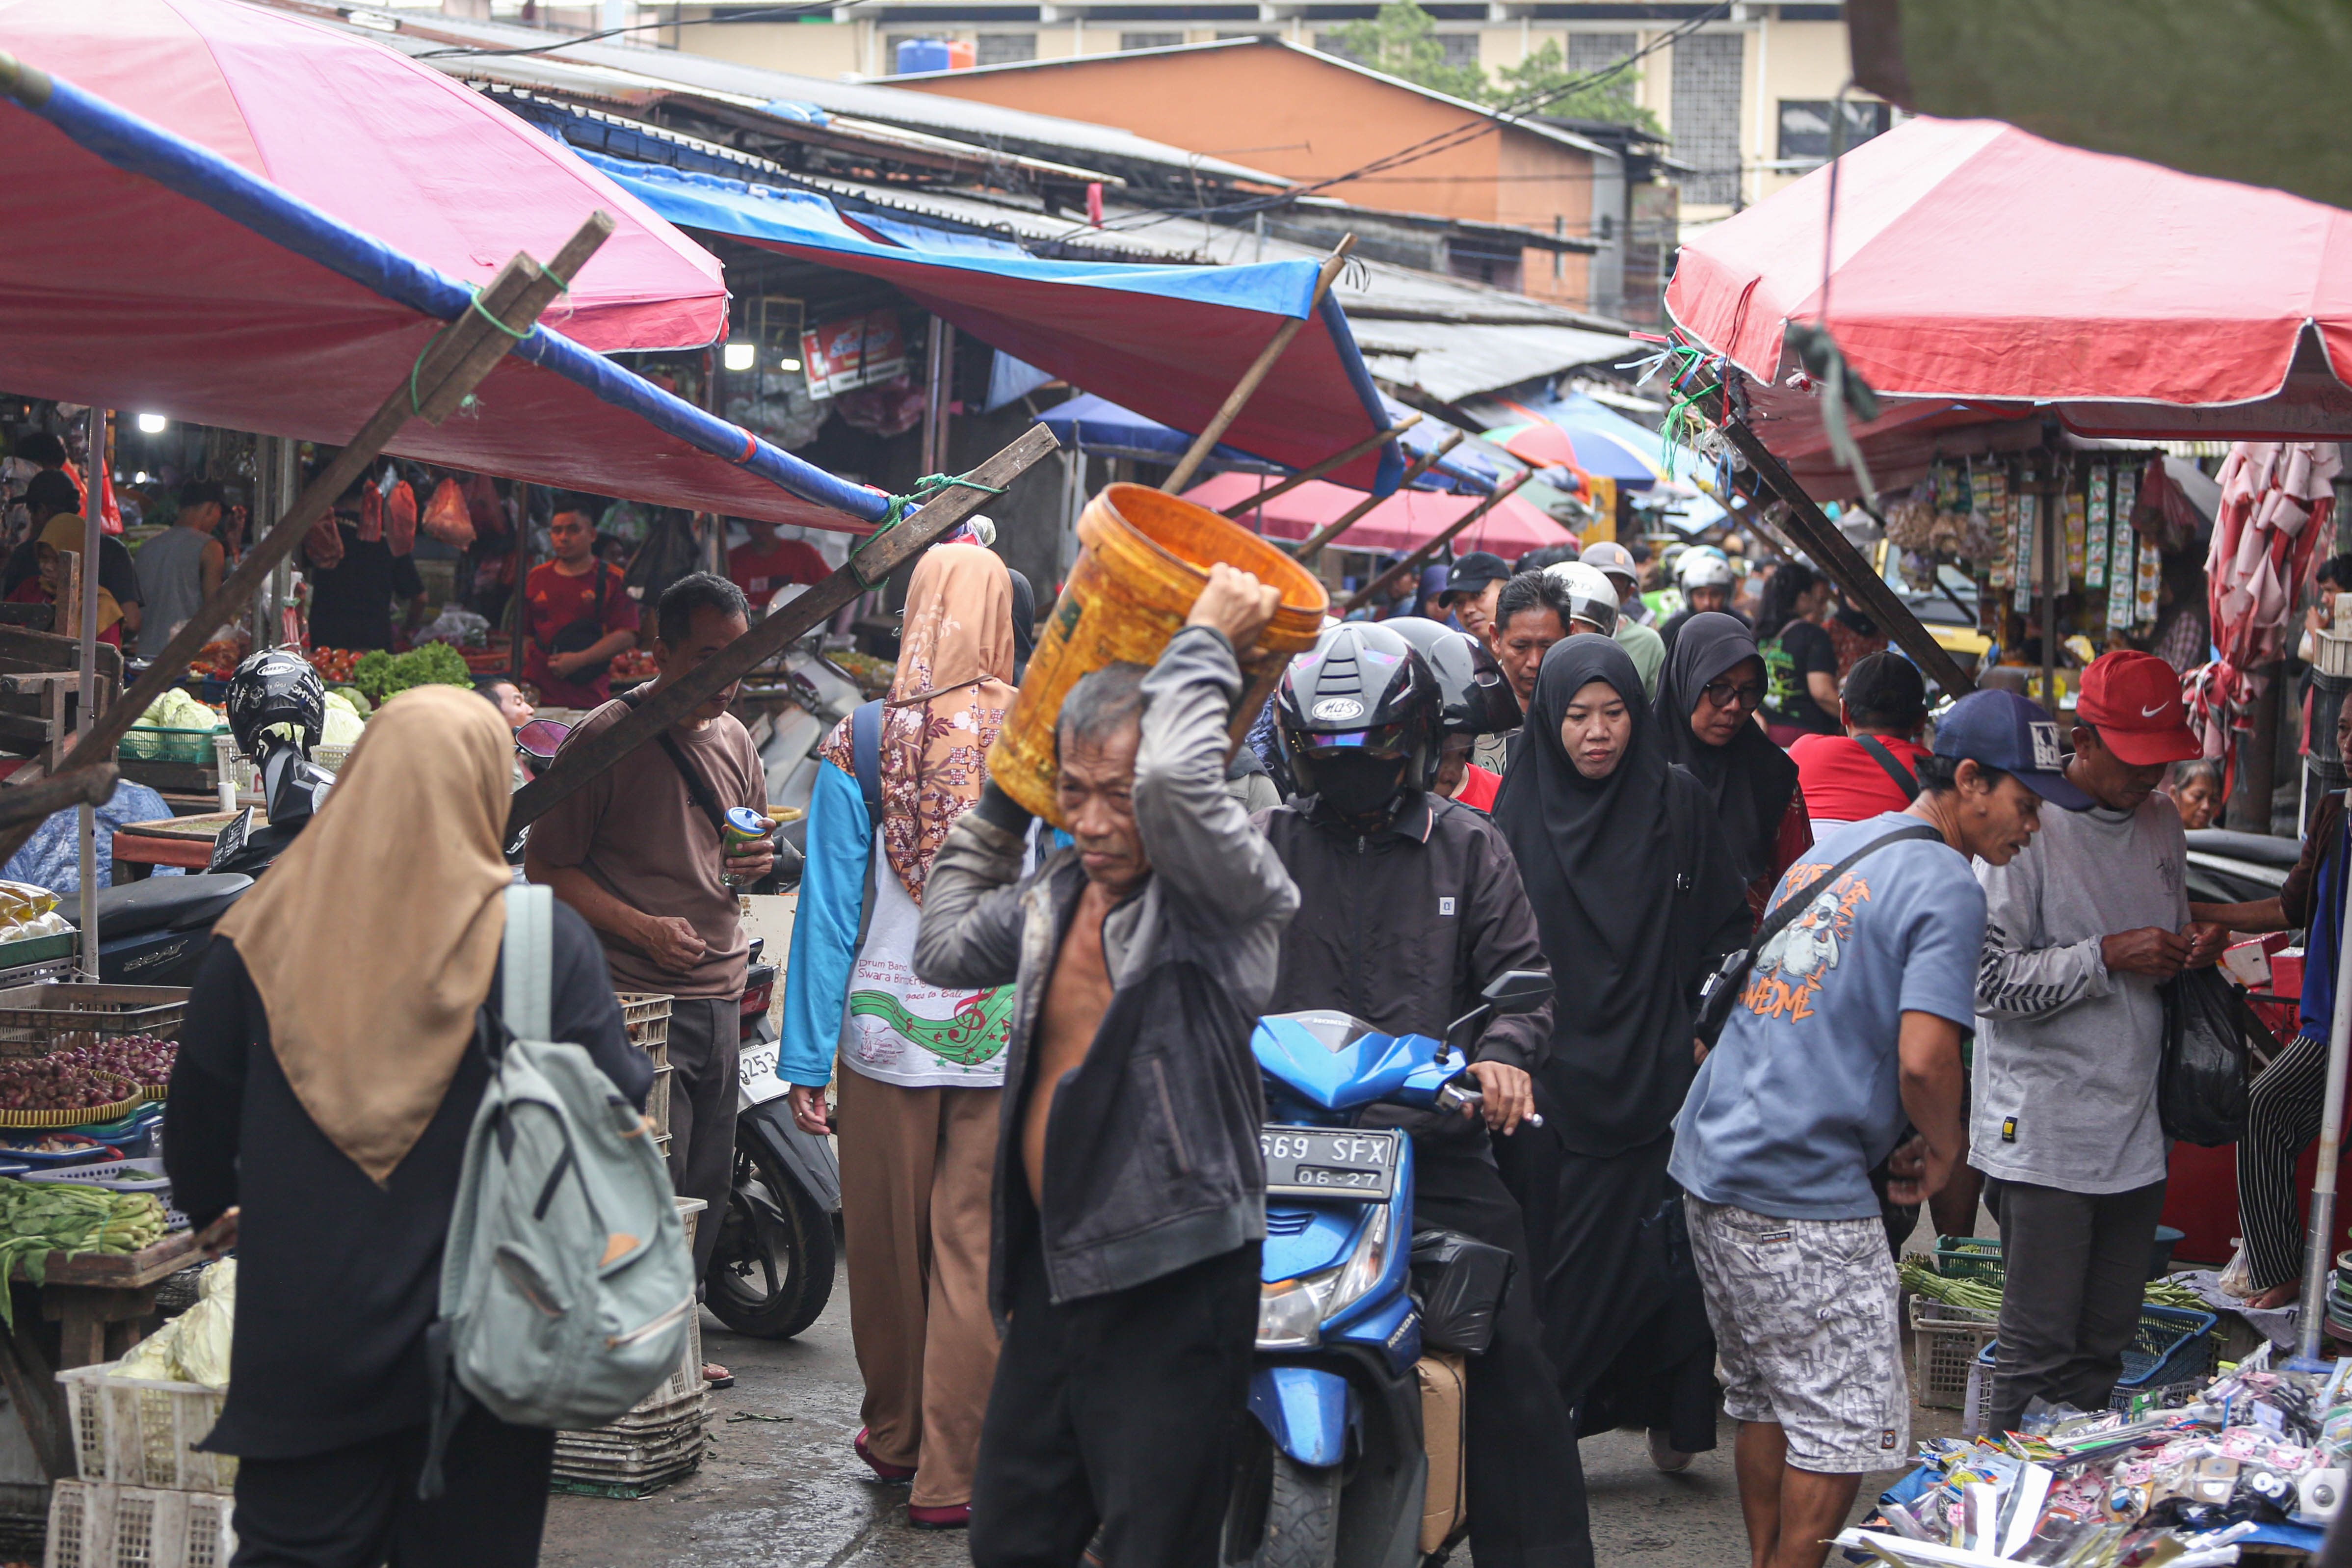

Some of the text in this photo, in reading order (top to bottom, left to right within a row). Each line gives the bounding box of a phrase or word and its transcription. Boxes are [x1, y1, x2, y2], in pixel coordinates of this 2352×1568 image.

[859, 959, 885, 968] Drum
[858, 968, 891, 982] Swara
[905, 993, 925, 1002] goes
[941, 988, 963, 998] Bali
[1331, 1138, 1385, 1164] SFX
